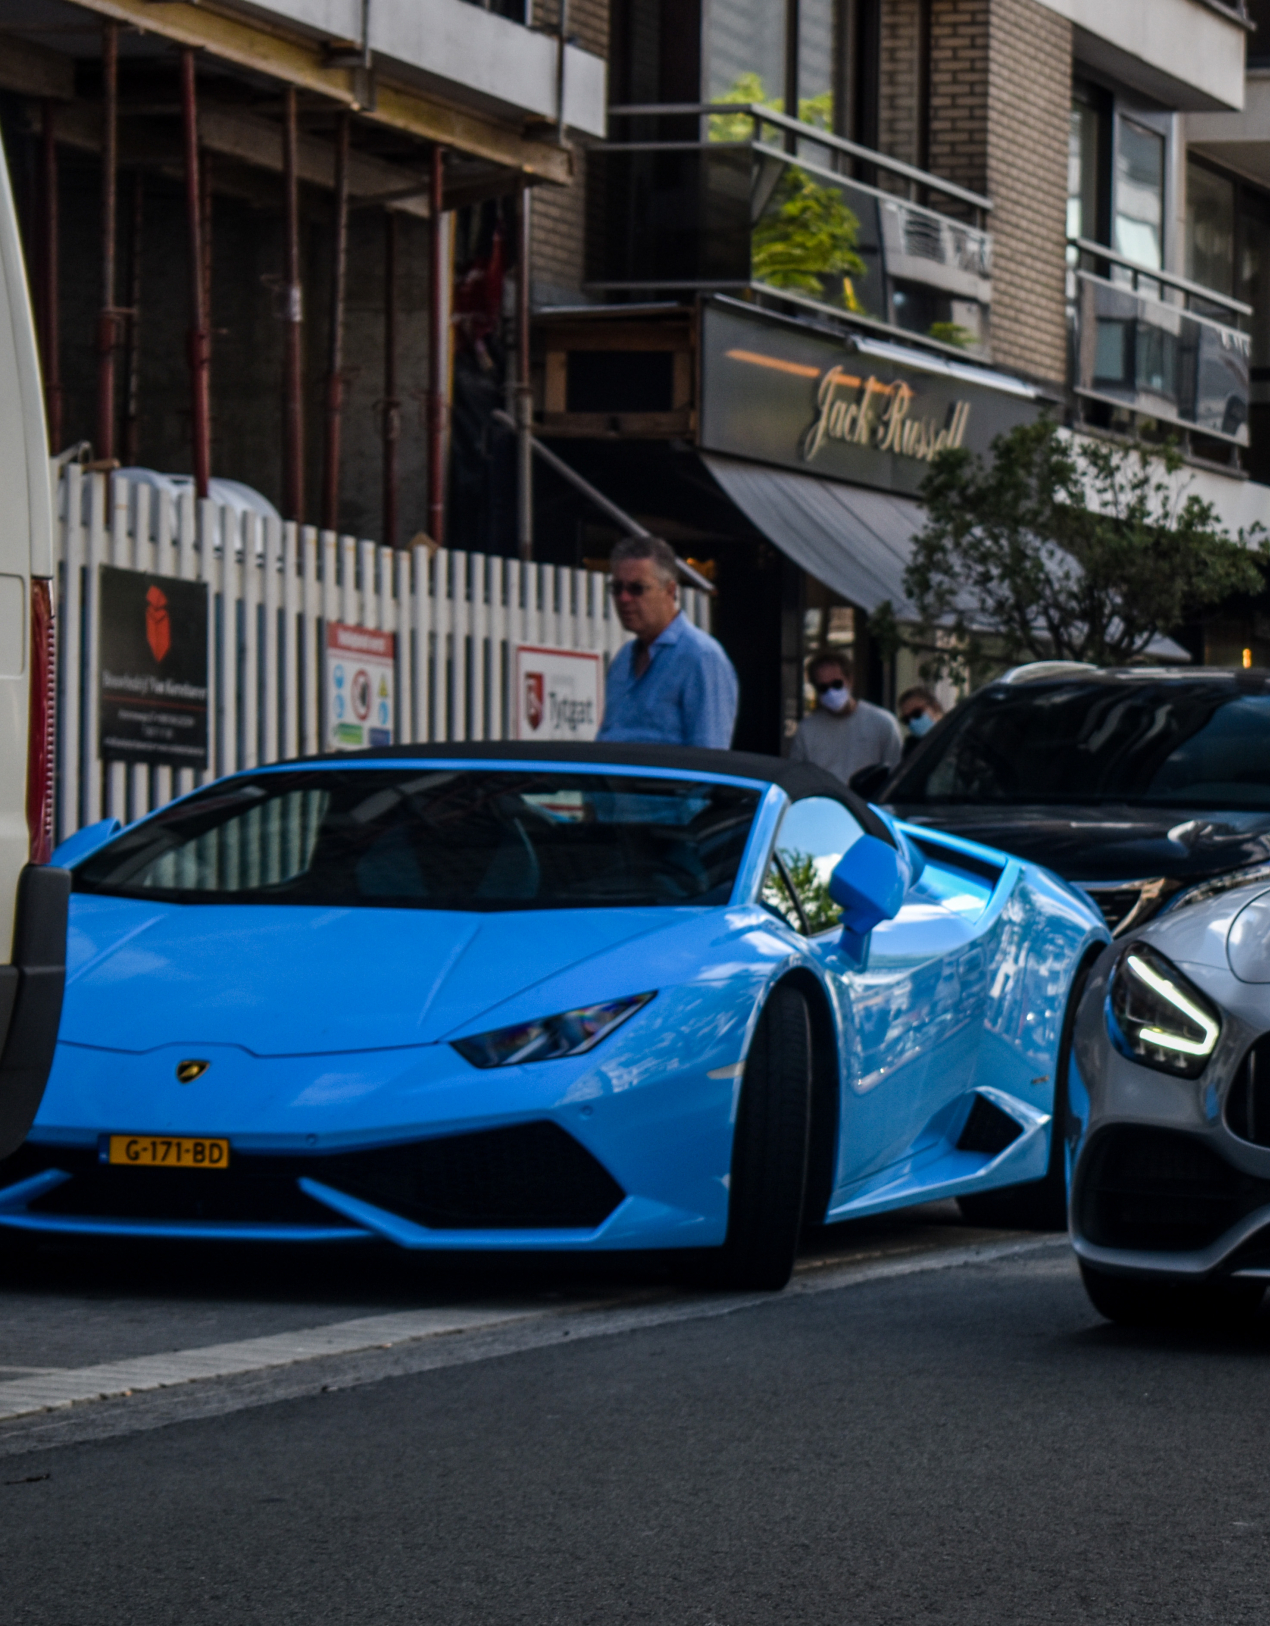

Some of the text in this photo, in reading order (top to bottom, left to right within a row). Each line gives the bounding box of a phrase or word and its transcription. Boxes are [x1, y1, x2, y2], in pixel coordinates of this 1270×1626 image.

[804, 364, 972, 462] Jack Russell
[549, 691, 593, 731] Tytgat
[125, 1139, 224, 1164] G-171-BD
